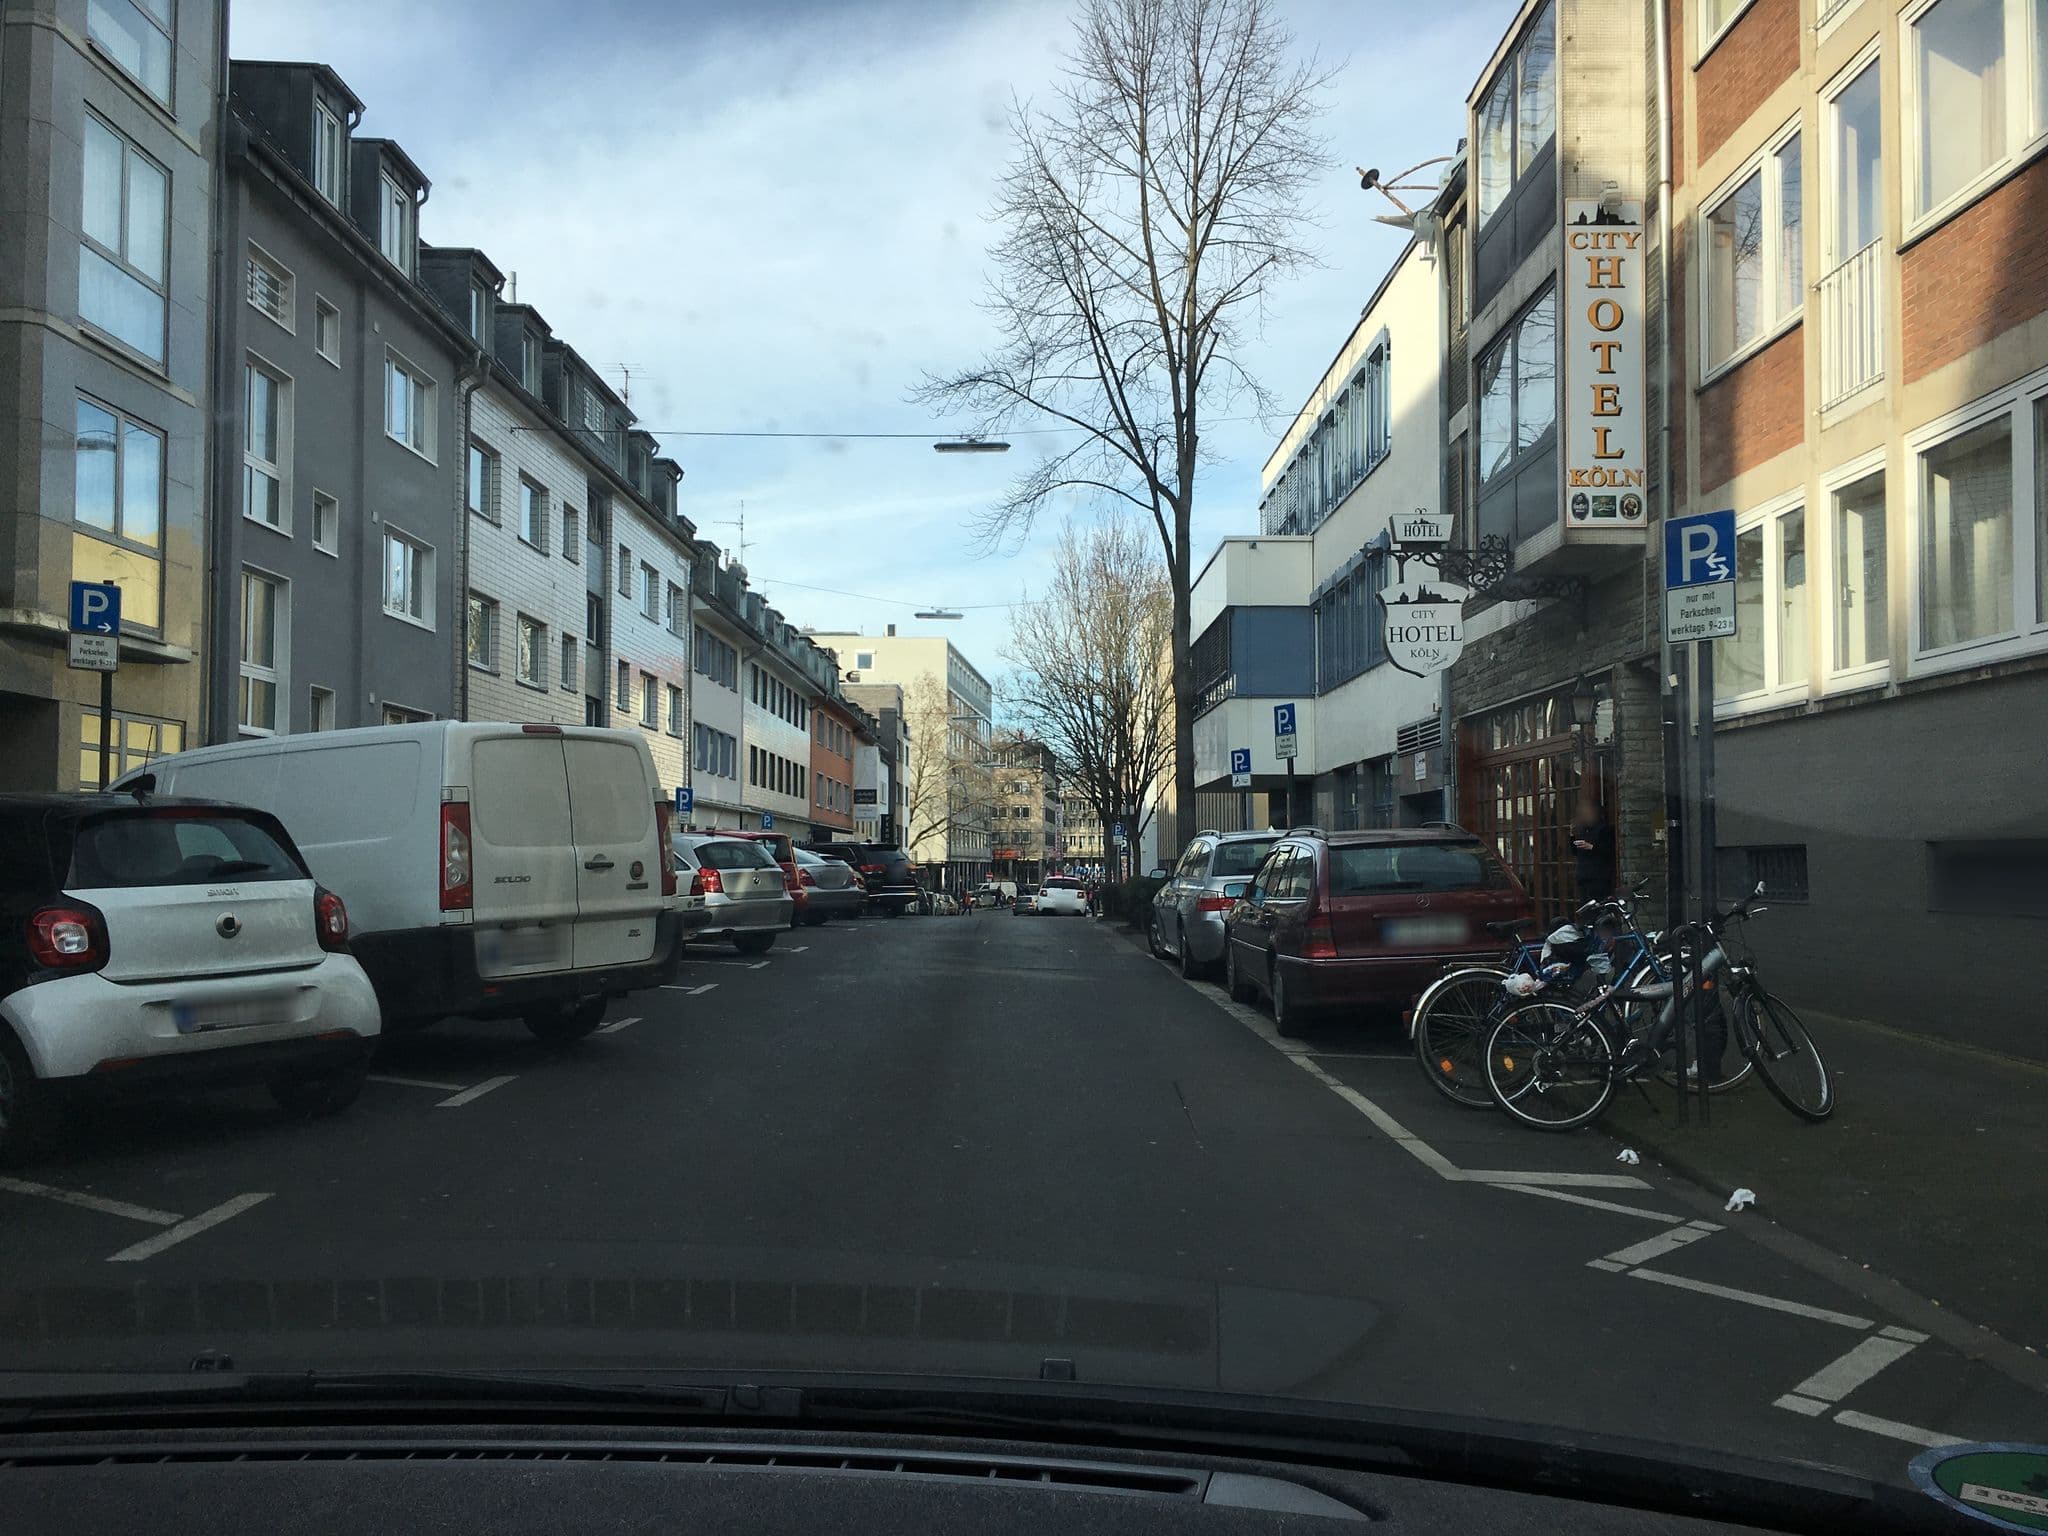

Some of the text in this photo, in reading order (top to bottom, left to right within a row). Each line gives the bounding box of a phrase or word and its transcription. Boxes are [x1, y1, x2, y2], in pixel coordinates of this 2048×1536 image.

[1568, 231, 1642, 250] CITY
[1585, 255, 1626, 459] HOTEL
[1568, 465, 1644, 488] KÖLN
[1404, 524, 1443, 538] HOTEL
[1681, 524, 1719, 582] P
[1686, 591, 1715, 604] nur mit
[83, 589, 109, 625] P
[1411, 610, 1436, 620] CITY
[1680, 606, 1722, 620] Parkschein
[1388, 625, 1463, 643] HOTEL
[1671, 623, 1706, 636] werktags
[1708, 620, 1728, 632] 9-23
[1410, 649, 1440, 658] KÖLN
[1277, 708, 1289, 734] P
[1233, 752, 1245, 772] P
[680, 790, 689, 810] P
[764, 815, 771, 827] P
